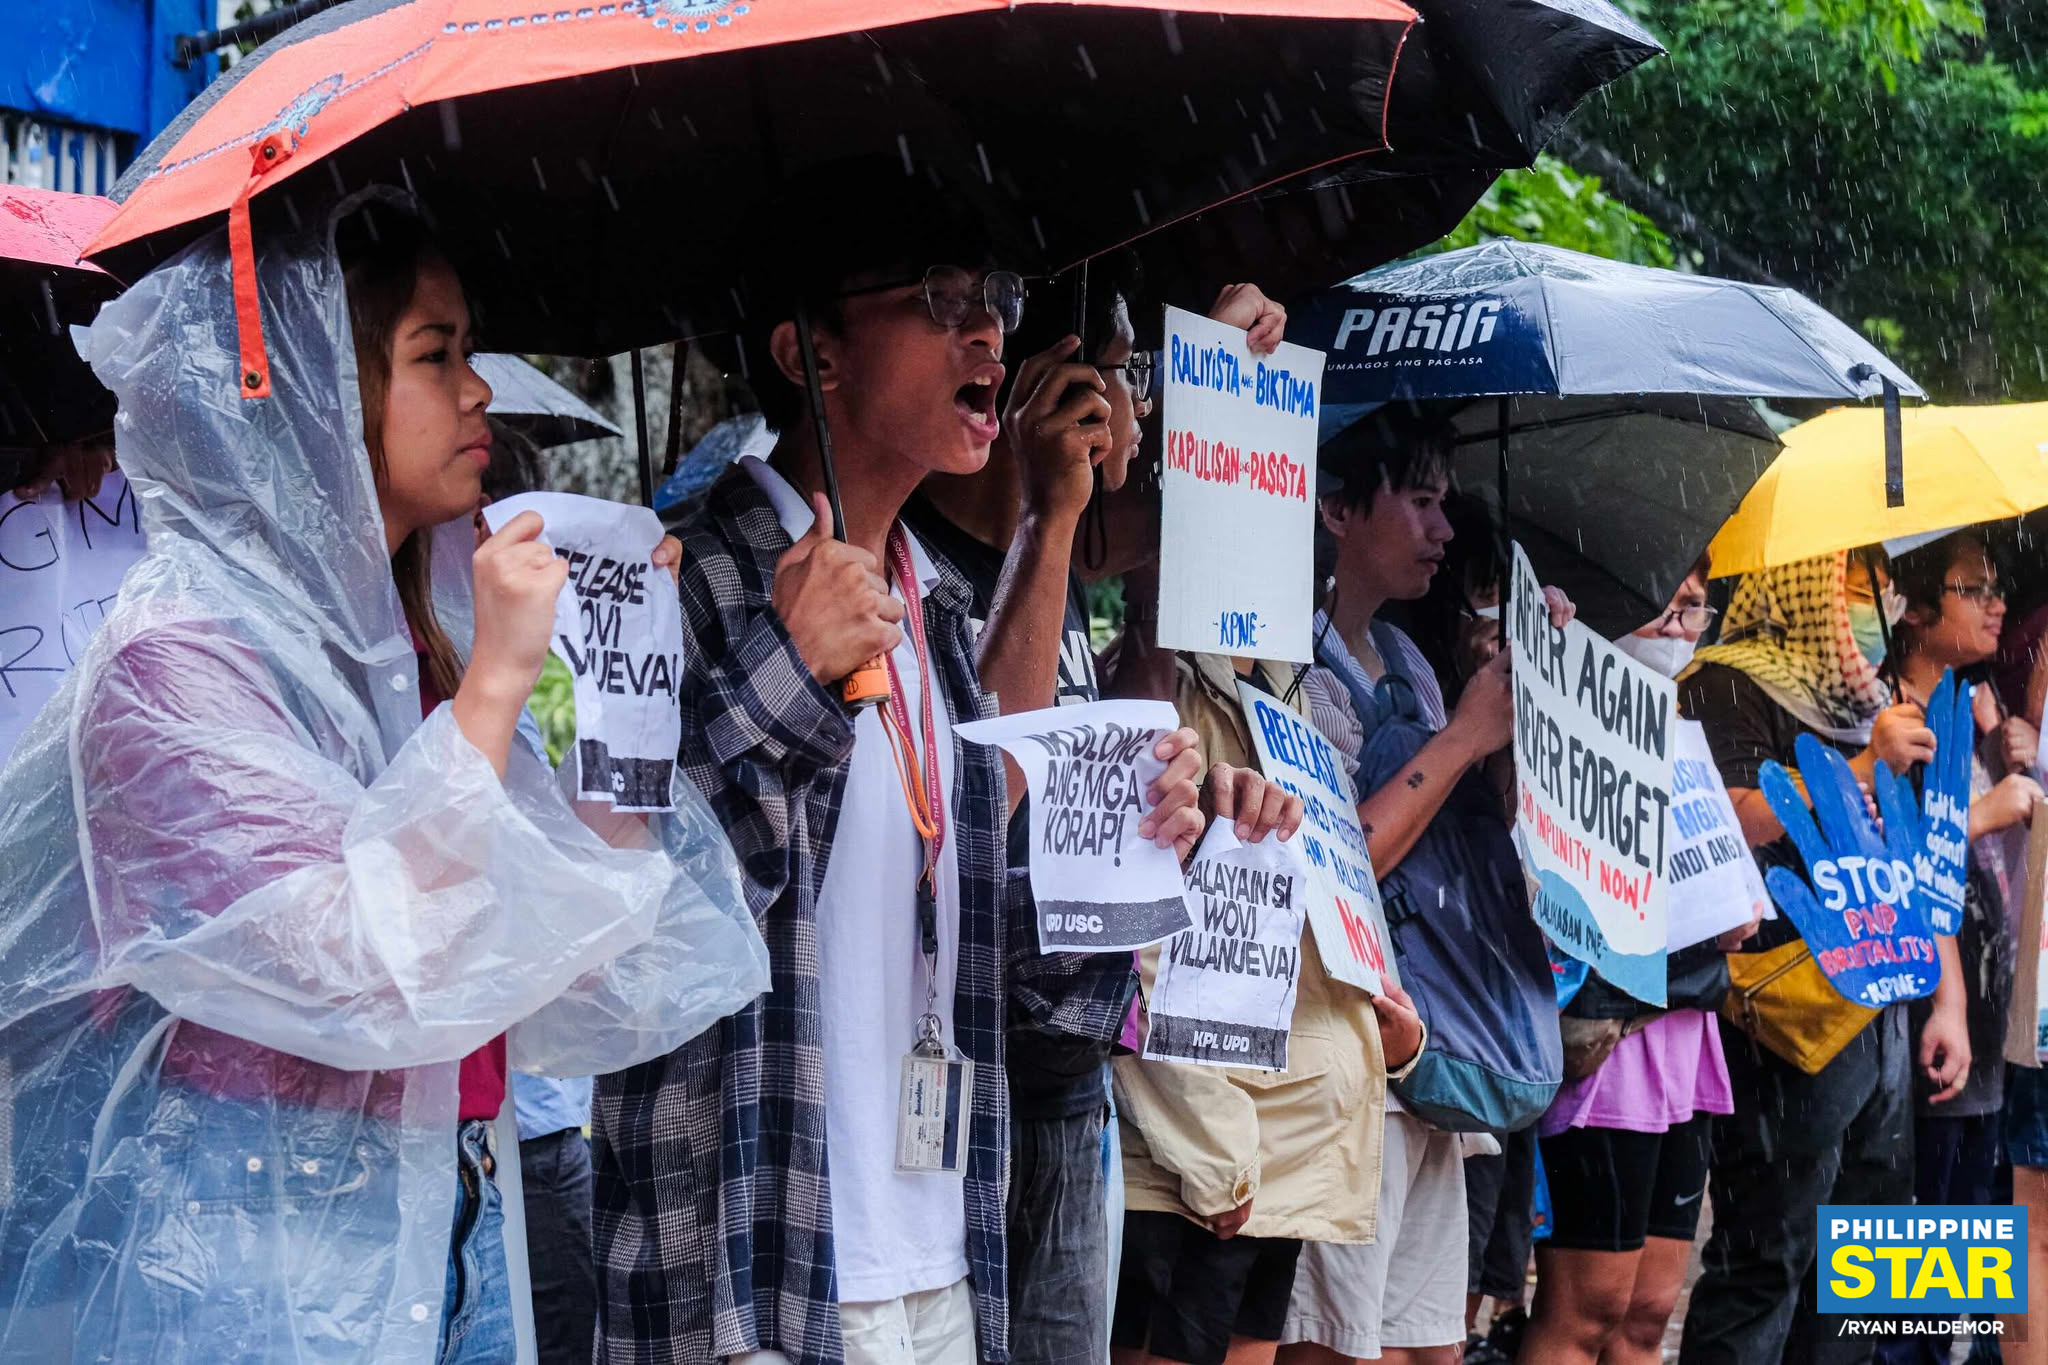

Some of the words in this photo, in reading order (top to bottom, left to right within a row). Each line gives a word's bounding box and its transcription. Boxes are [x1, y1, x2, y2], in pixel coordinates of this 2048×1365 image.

[1256, 362, 1315, 419] BIKTIMA
[1327, 360, 1389, 371] UMAAGOS
[1428, 357, 1483, 367] PAG-ASA
[1168, 429, 1240, 486] KAPULISAN
[1250, 451, 1307, 503] PASISTA
[579, 600, 621, 648] OVI
[1516, 558, 1567, 697] NEVER
[1576, 637, 1668, 761] AGAIN
[928, 744, 938, 799] PHILIPPINES
[1254, 700, 1348, 803] RELEASE
[1515, 670, 1566, 808] NEVER
[1568, 735, 1670, 879] FORGET
[1042, 759, 1082, 807] ANG
[1081, 764, 1142, 813] MGA
[1043, 807, 1126, 868] KORAP!
[1669, 844, 1709, 885] INDI
[1272, 873, 1293, 909] SI
[1600, 859, 1653, 921] NOW!
[1812, 855, 1915, 912] STOP
[1065, 913, 1103, 934] USC
[1204, 894, 1257, 940] WOVI
[1843, 902, 1898, 940] PNP
[1169, 930, 1297, 989] VILLANUEVA!
[1818, 936, 1935, 977] BRUTALITY
[1193, 1031, 1219, 1049] KPL
[1222, 1034, 1250, 1052] UPD
